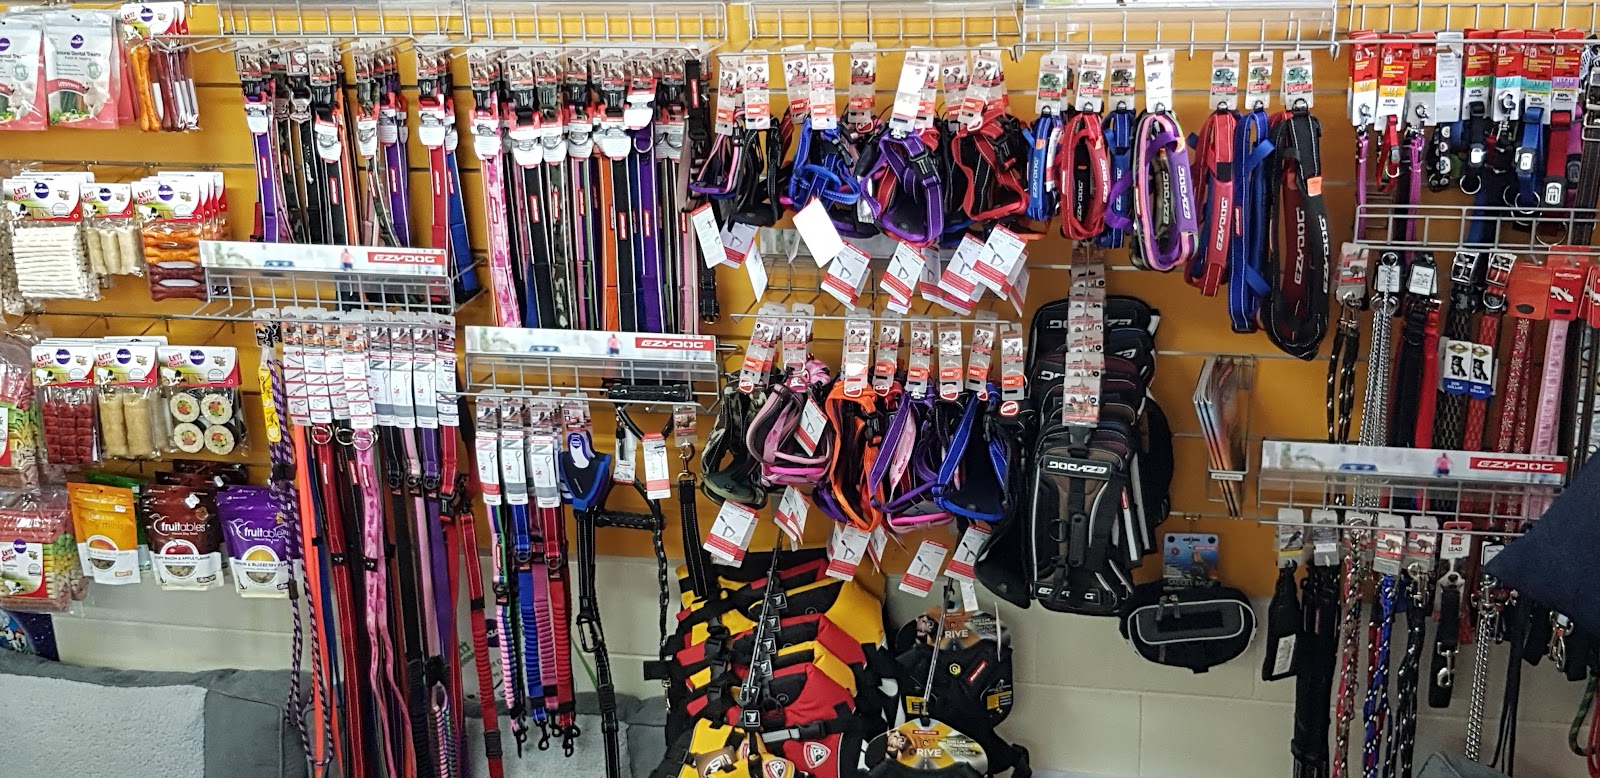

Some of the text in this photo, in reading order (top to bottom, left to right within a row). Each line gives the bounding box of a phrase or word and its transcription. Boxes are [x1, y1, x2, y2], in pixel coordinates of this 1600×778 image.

[1100, 158, 1108, 203] EZYDOG
[1178, 165, 1190, 219] EZYDOG
[1216, 197, 1228, 250] EZYDOG
[1294, 208, 1305, 285] EZYDOG
[373, 254, 436, 263] EZYDOG
[1318, 215, 1329, 294] EZYDOG
[641, 340, 705, 349] EZYDOG
[1047, 460, 1107, 474] EZYDOG
[1477, 460, 1554, 471] EZYDOG
[161, 521, 205, 532] fruitables
[244, 527, 286, 538] fruitable
